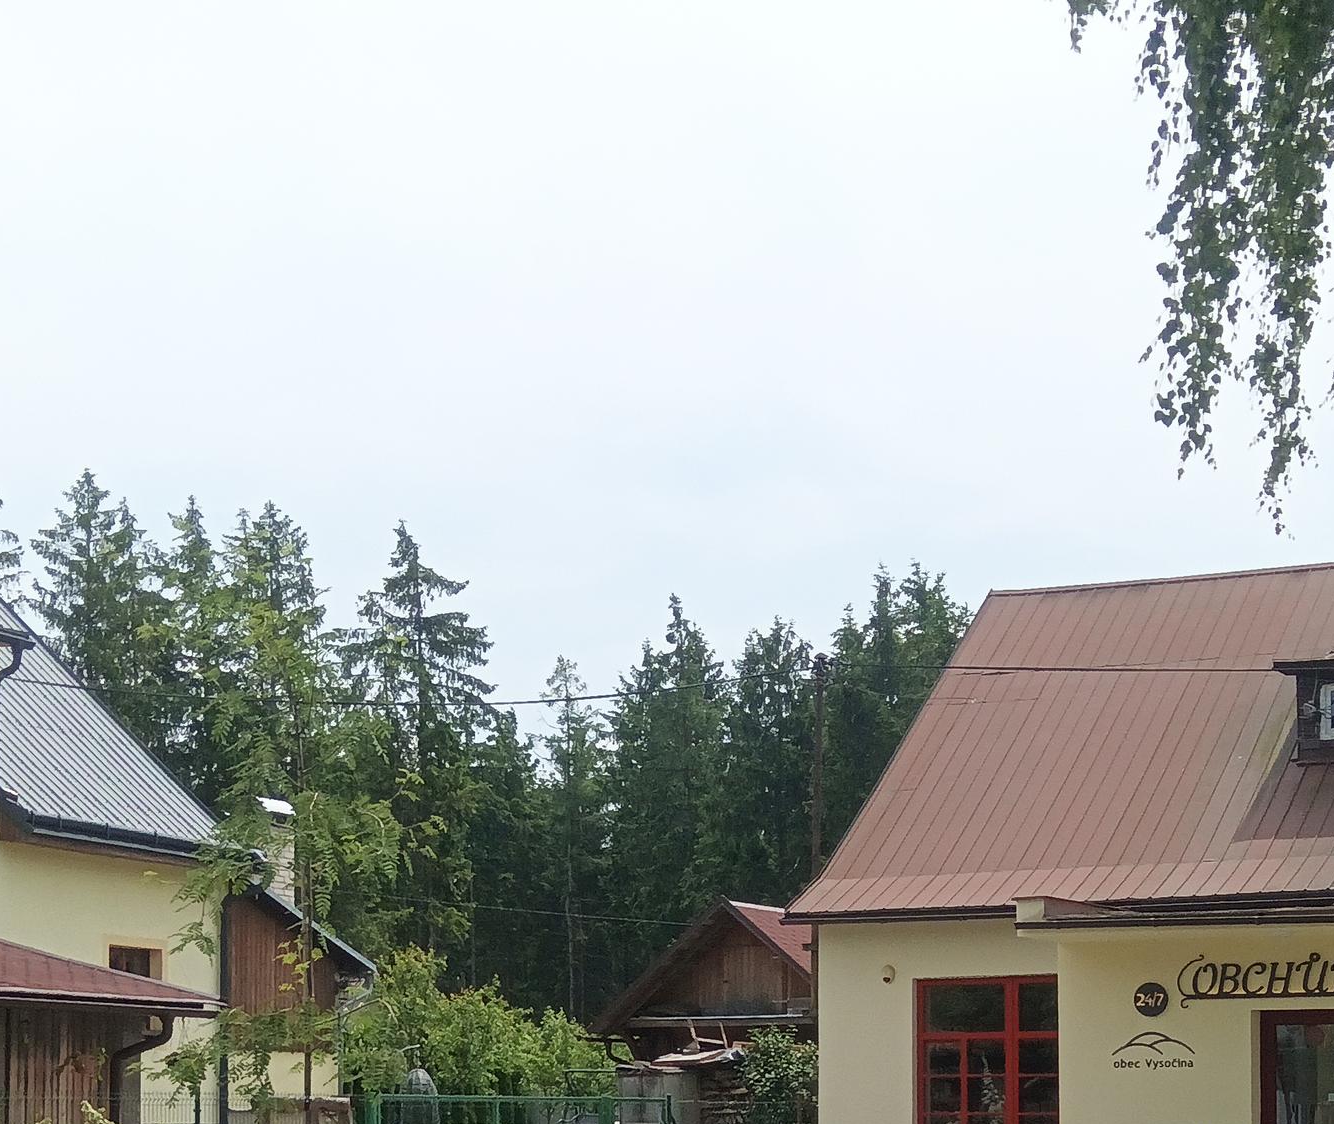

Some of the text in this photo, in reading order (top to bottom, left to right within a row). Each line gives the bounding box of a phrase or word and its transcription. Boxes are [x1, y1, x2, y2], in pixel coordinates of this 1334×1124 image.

[1136, 991, 1165, 1007] 24/7
[1113, 1058, 1194, 1070] obec Vysočina
